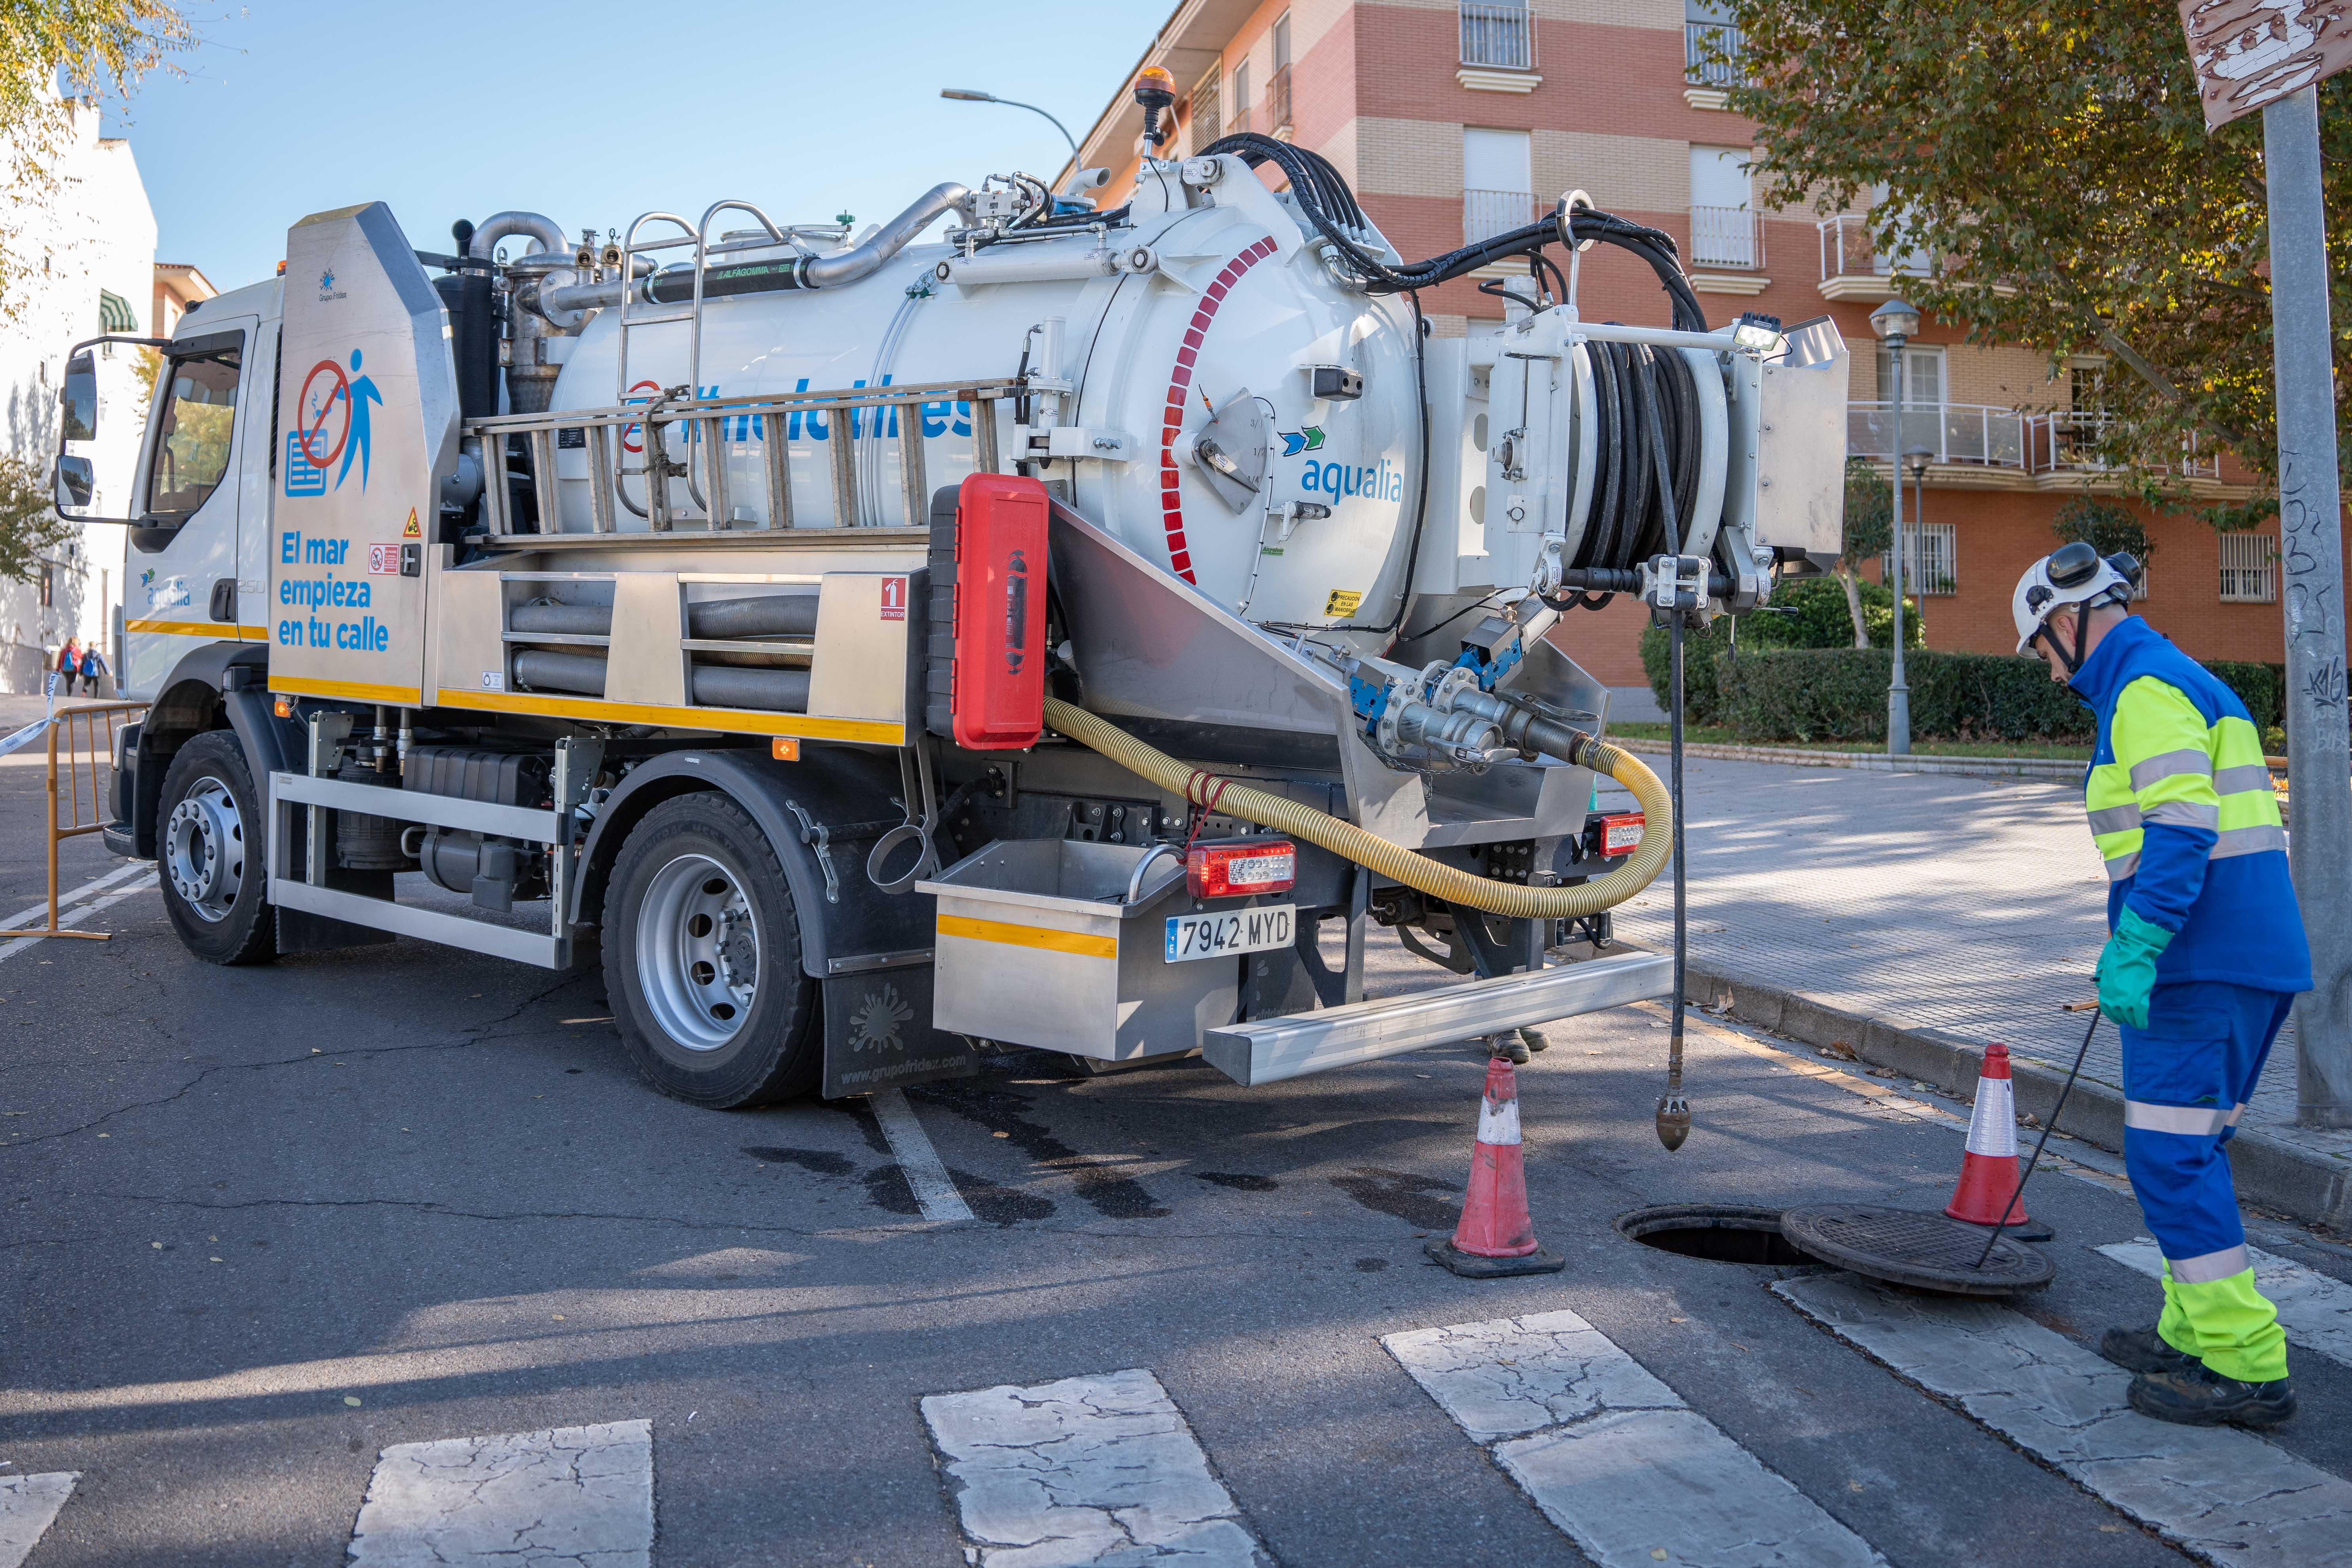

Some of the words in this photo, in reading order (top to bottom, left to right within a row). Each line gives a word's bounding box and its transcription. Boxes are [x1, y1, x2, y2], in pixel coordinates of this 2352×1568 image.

[319, 294, 332, 302] Grupo
[333, 291, 347, 299] Fridex
[1301, 459, 1404, 506] aqualia
[281, 530, 300, 564] El
[306, 538, 349, 565] mar
[237, 580, 265, 593] 250
[280, 572, 371, 613] empieza
[278, 620, 302, 646] en
[309, 616, 330, 648] tu
[336, 616, 388, 652] calle
[1169, 944, 1174, 954] E
[1183, 917, 1239, 954] 7942
[1248, 911, 1288, 946] MYD
[841, 1055, 966, 1085] www.grupofridex.com
